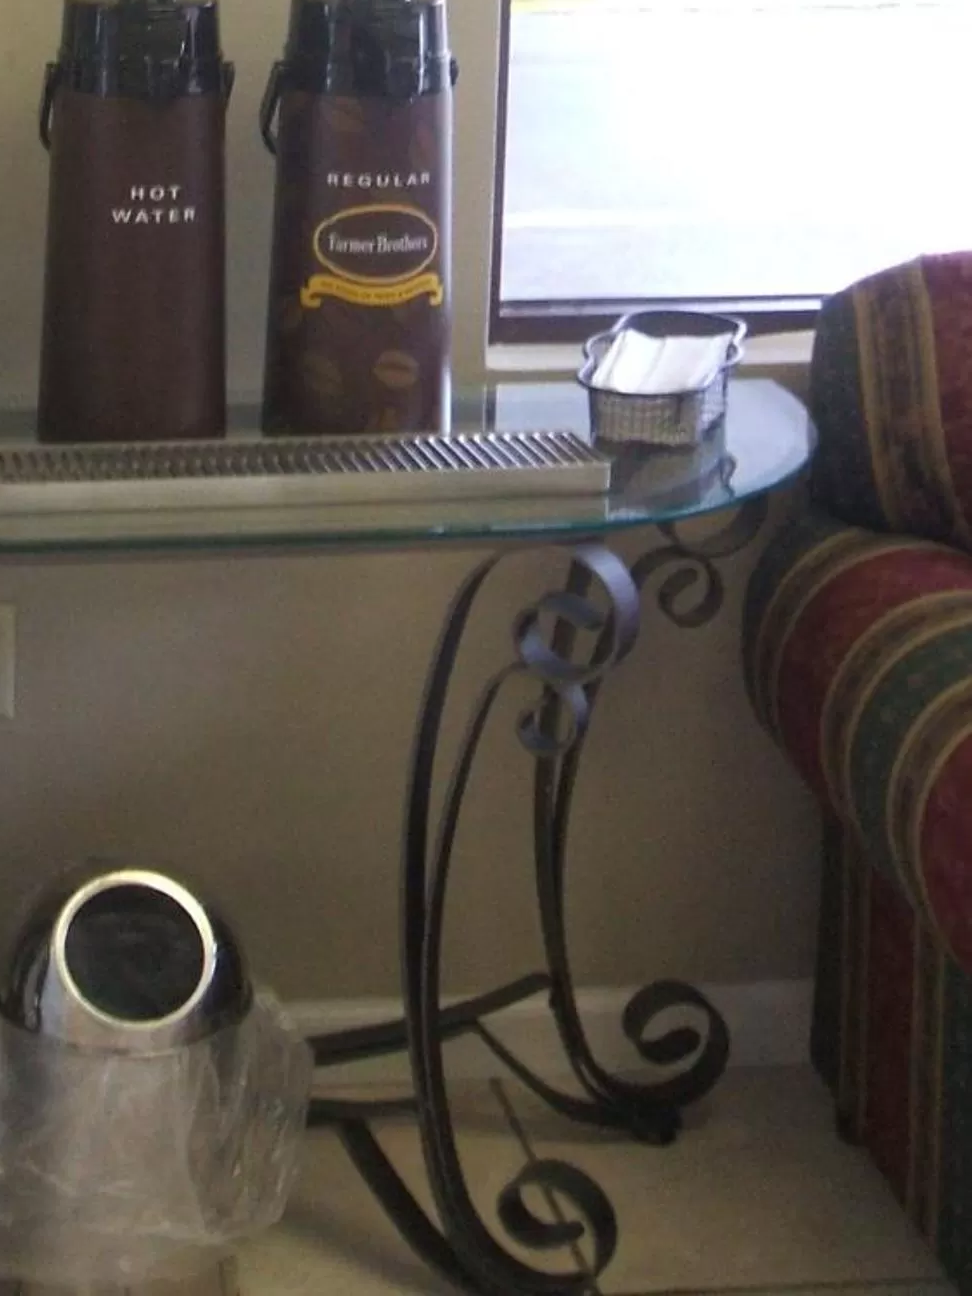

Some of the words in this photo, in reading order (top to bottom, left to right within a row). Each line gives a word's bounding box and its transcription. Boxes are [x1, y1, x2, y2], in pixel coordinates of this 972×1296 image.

[327, 172, 431, 188] REGULAR
[131, 184, 180, 201] HOT
[111, 207, 196, 224] WATER
[329, 232, 373, 254] Farmer
[378, 231, 427, 253] Brothers
